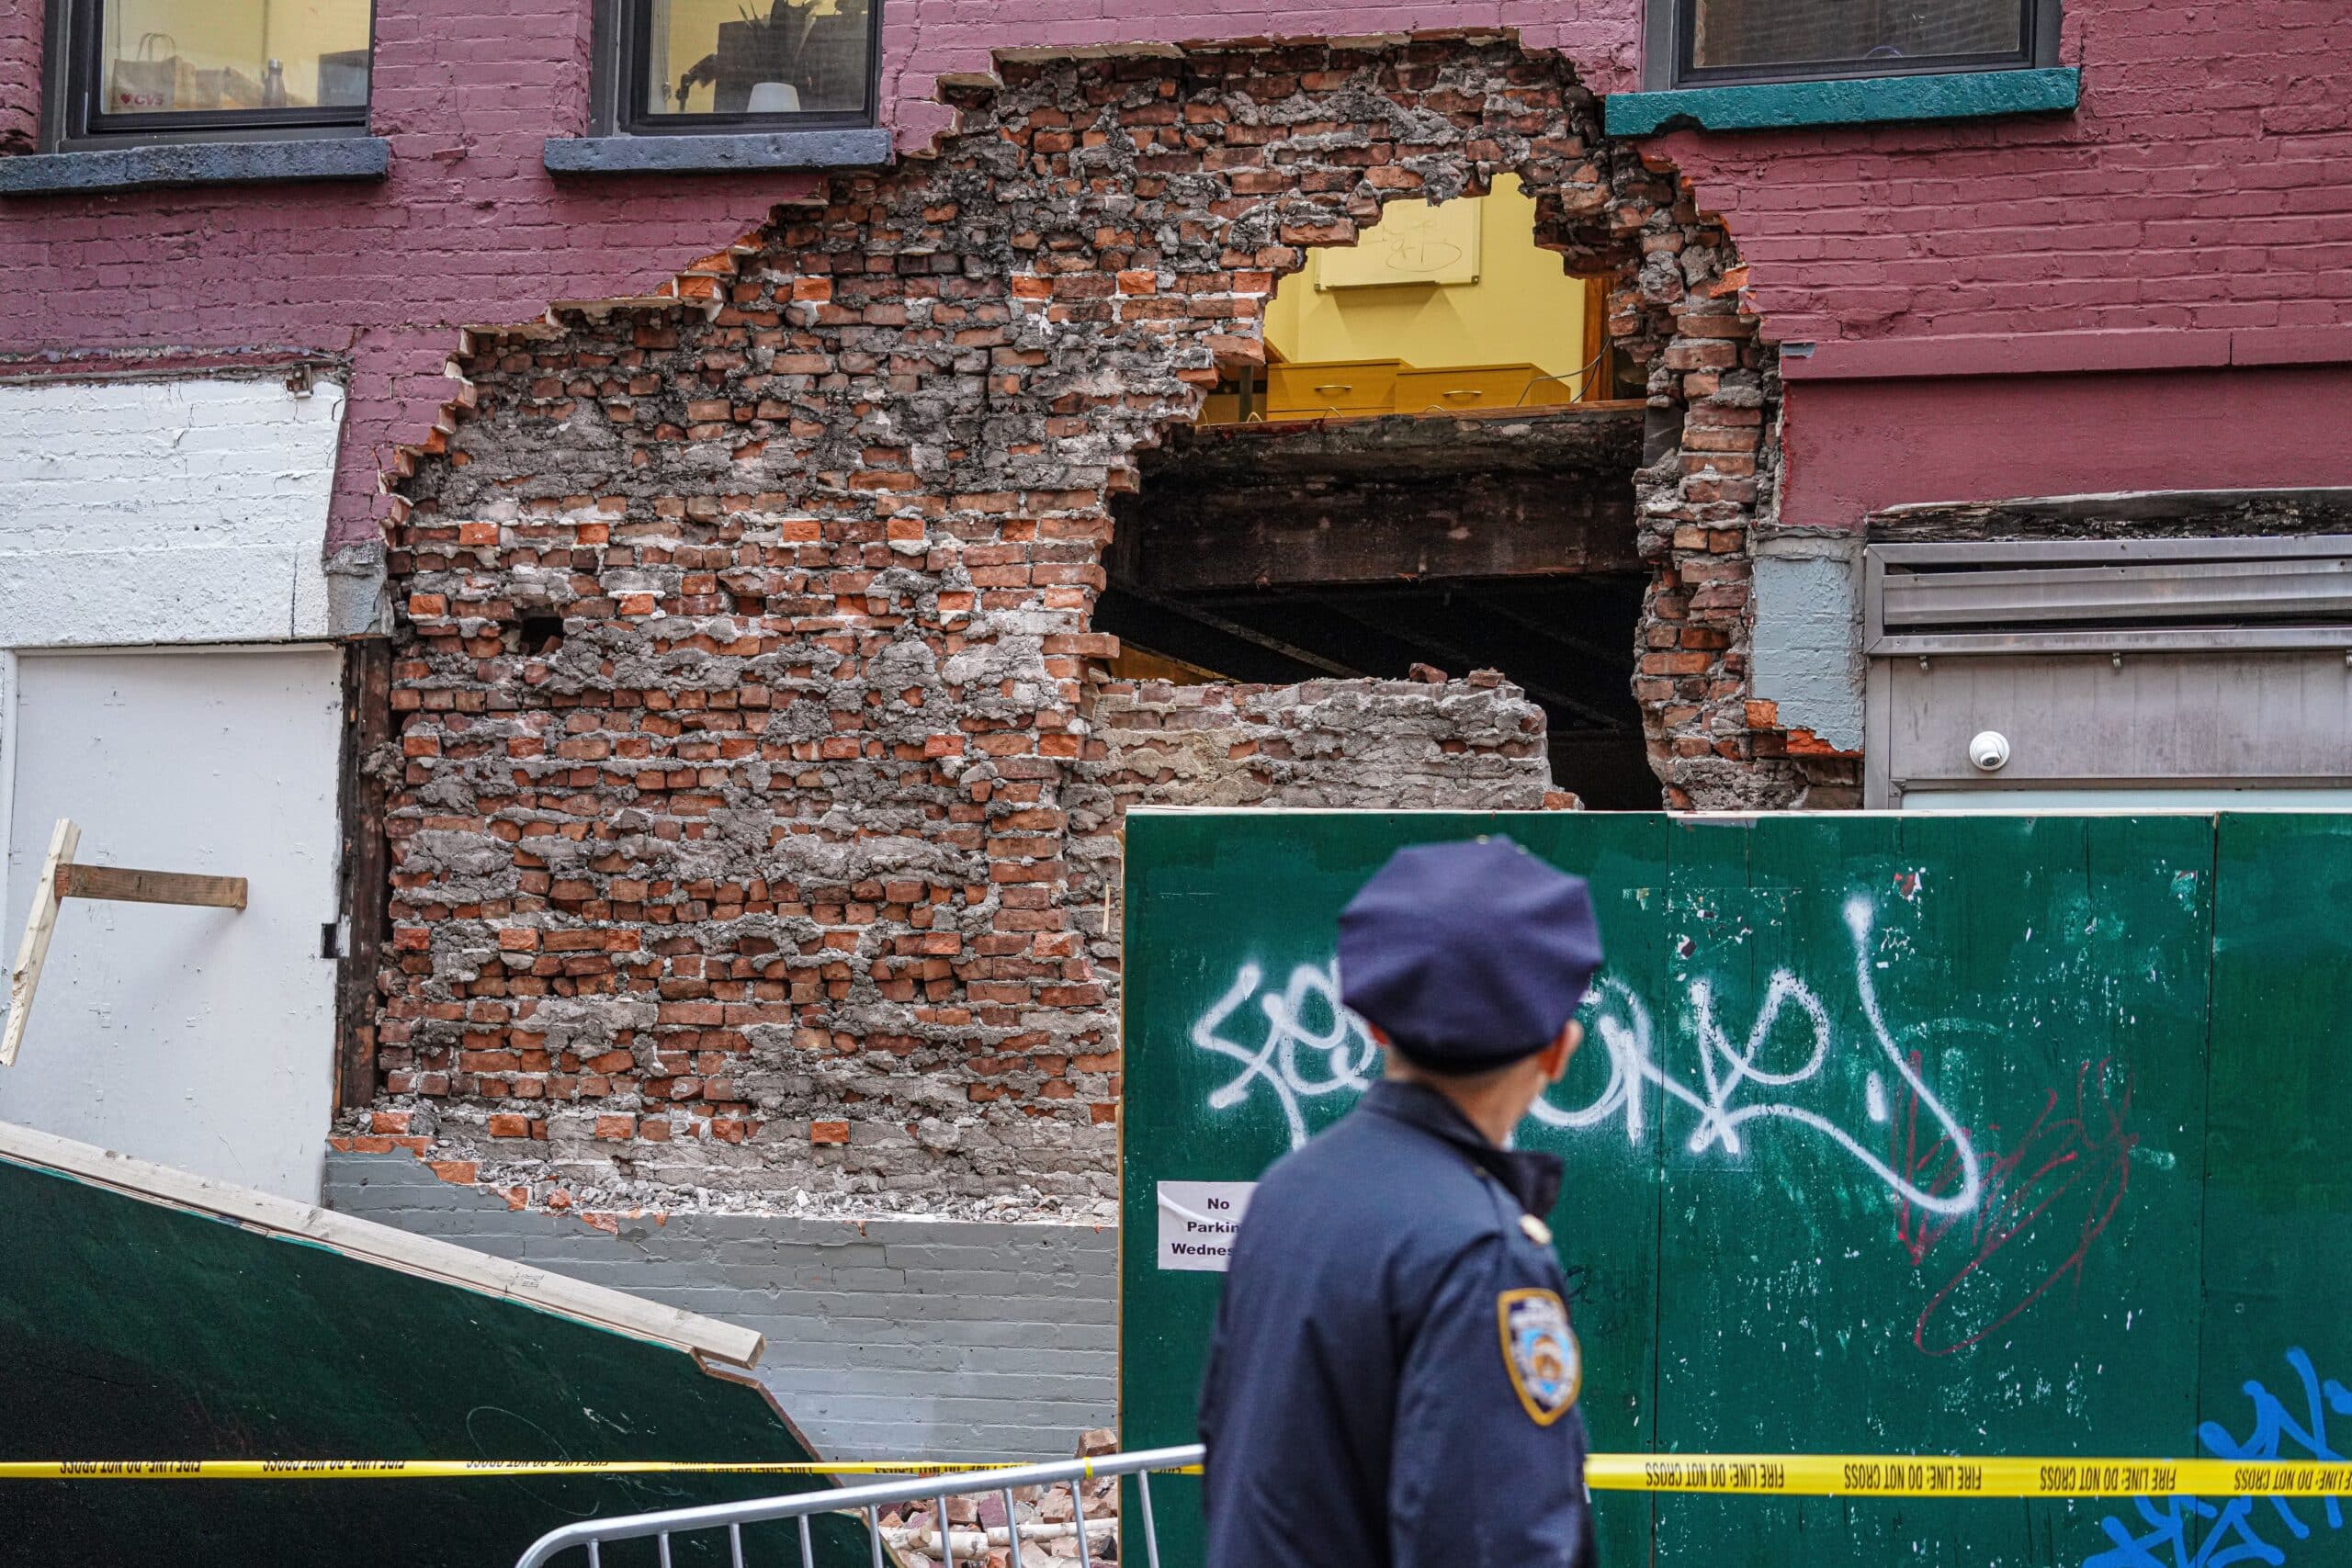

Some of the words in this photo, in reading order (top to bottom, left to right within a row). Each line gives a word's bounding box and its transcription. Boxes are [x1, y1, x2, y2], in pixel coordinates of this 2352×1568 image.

[1207, 1198, 1230, 1210] No
[1187, 1221, 1239, 1234] Parkin
[1171, 1243, 1234, 1257] Wednes
[1645, 1461, 1681, 1486] CROSS
[1685, 1462, 1707, 1487] NOT
[1711, 1462, 1725, 1487] DO
[1729, 1463, 1757, 1488] LINE:
[1760, 1463, 1784, 1489] FIRE
[1844, 1463, 1881, 1489] CROSS
[1883, 1464, 1905, 1489] NOT
[1908, 1464, 1923, 1490] DO
[1927, 1465, 1954, 1490] LINE:
[1958, 1465, 1982, 1490] FIRE
[2040, 1465, 2076, 1491] CROSS
[2078, 1466, 2100, 1490] NOT
[2103, 1466, 2119, 1491] DO
[2121, 1466, 2148, 1491] LINE:
[2152, 1466, 2177, 1491] FIRE
[2234, 1467, 2271, 1491] CROSS
[2272, 1468, 2296, 1491] NOT
[2297, 1469, 2313, 1491] DO
